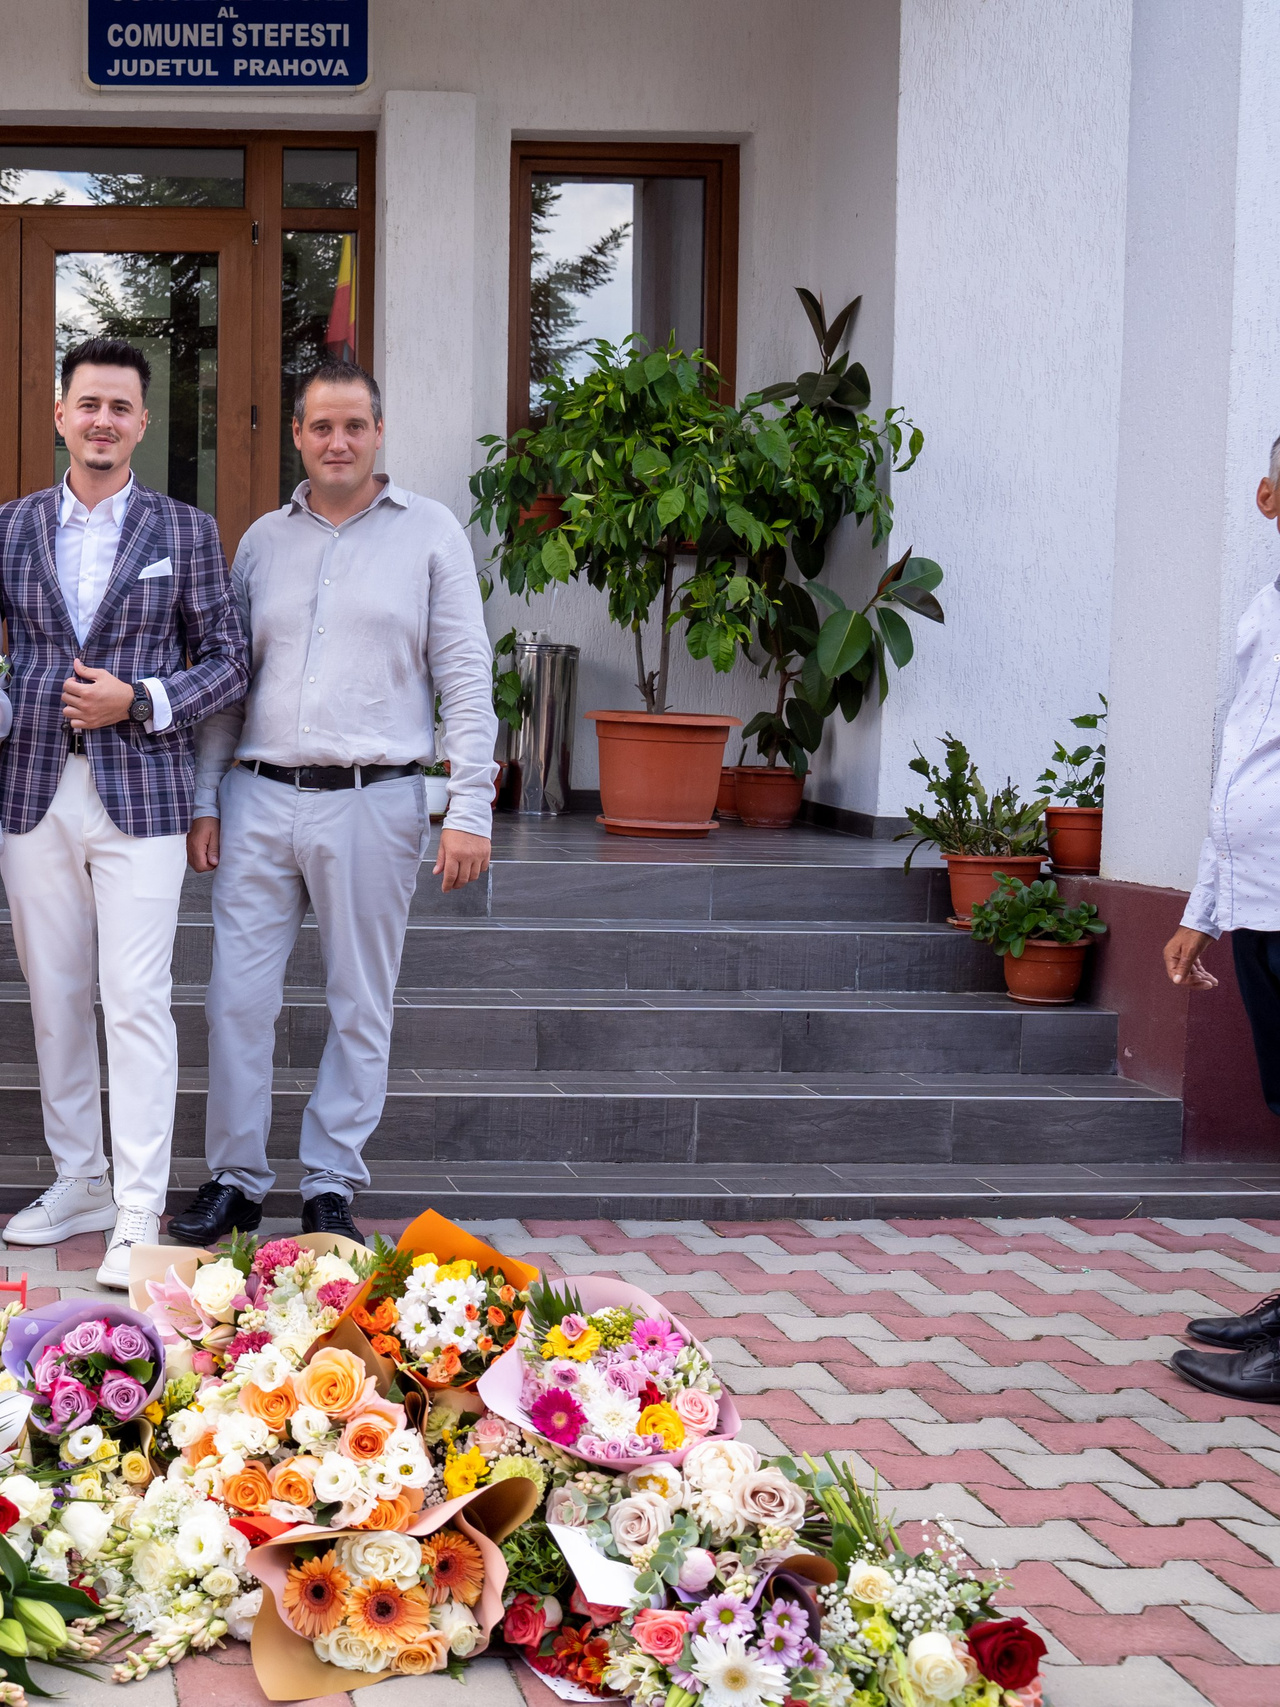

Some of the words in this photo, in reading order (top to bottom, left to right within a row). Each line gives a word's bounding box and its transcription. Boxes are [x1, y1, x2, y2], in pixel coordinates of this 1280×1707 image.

[217, 6, 239, 18] AL
[107, 23, 223, 47] COMUNEI
[232, 23, 349, 47] STEFESTI
[106, 59, 219, 77] JUDETUL
[233, 59, 349, 76] PRAHOVA
